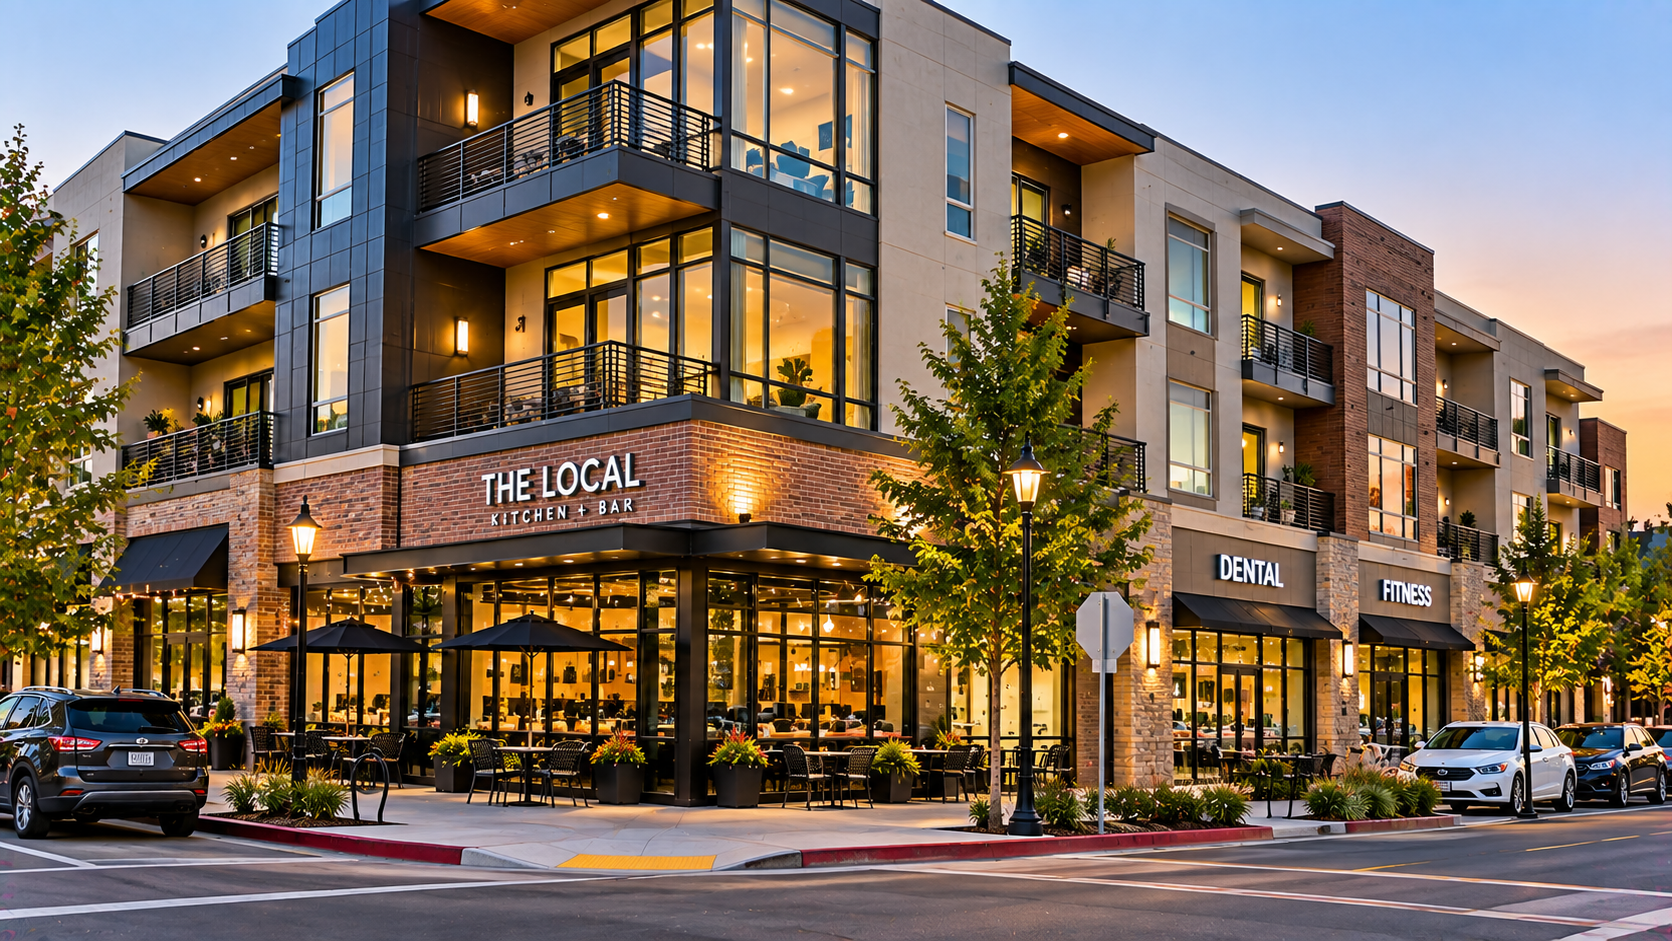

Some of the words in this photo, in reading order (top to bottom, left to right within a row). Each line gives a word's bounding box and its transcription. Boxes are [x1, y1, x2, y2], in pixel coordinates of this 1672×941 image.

[481, 467, 532, 506] THE
[542, 452, 642, 498] LOCAL
[491, 504, 568, 527] KITCHEN
[577, 503, 588, 517] +
[598, 497, 634, 516] BAR
[1219, 553, 1285, 588] DENTAL
[1382, 578, 1433, 608] FITNESS
